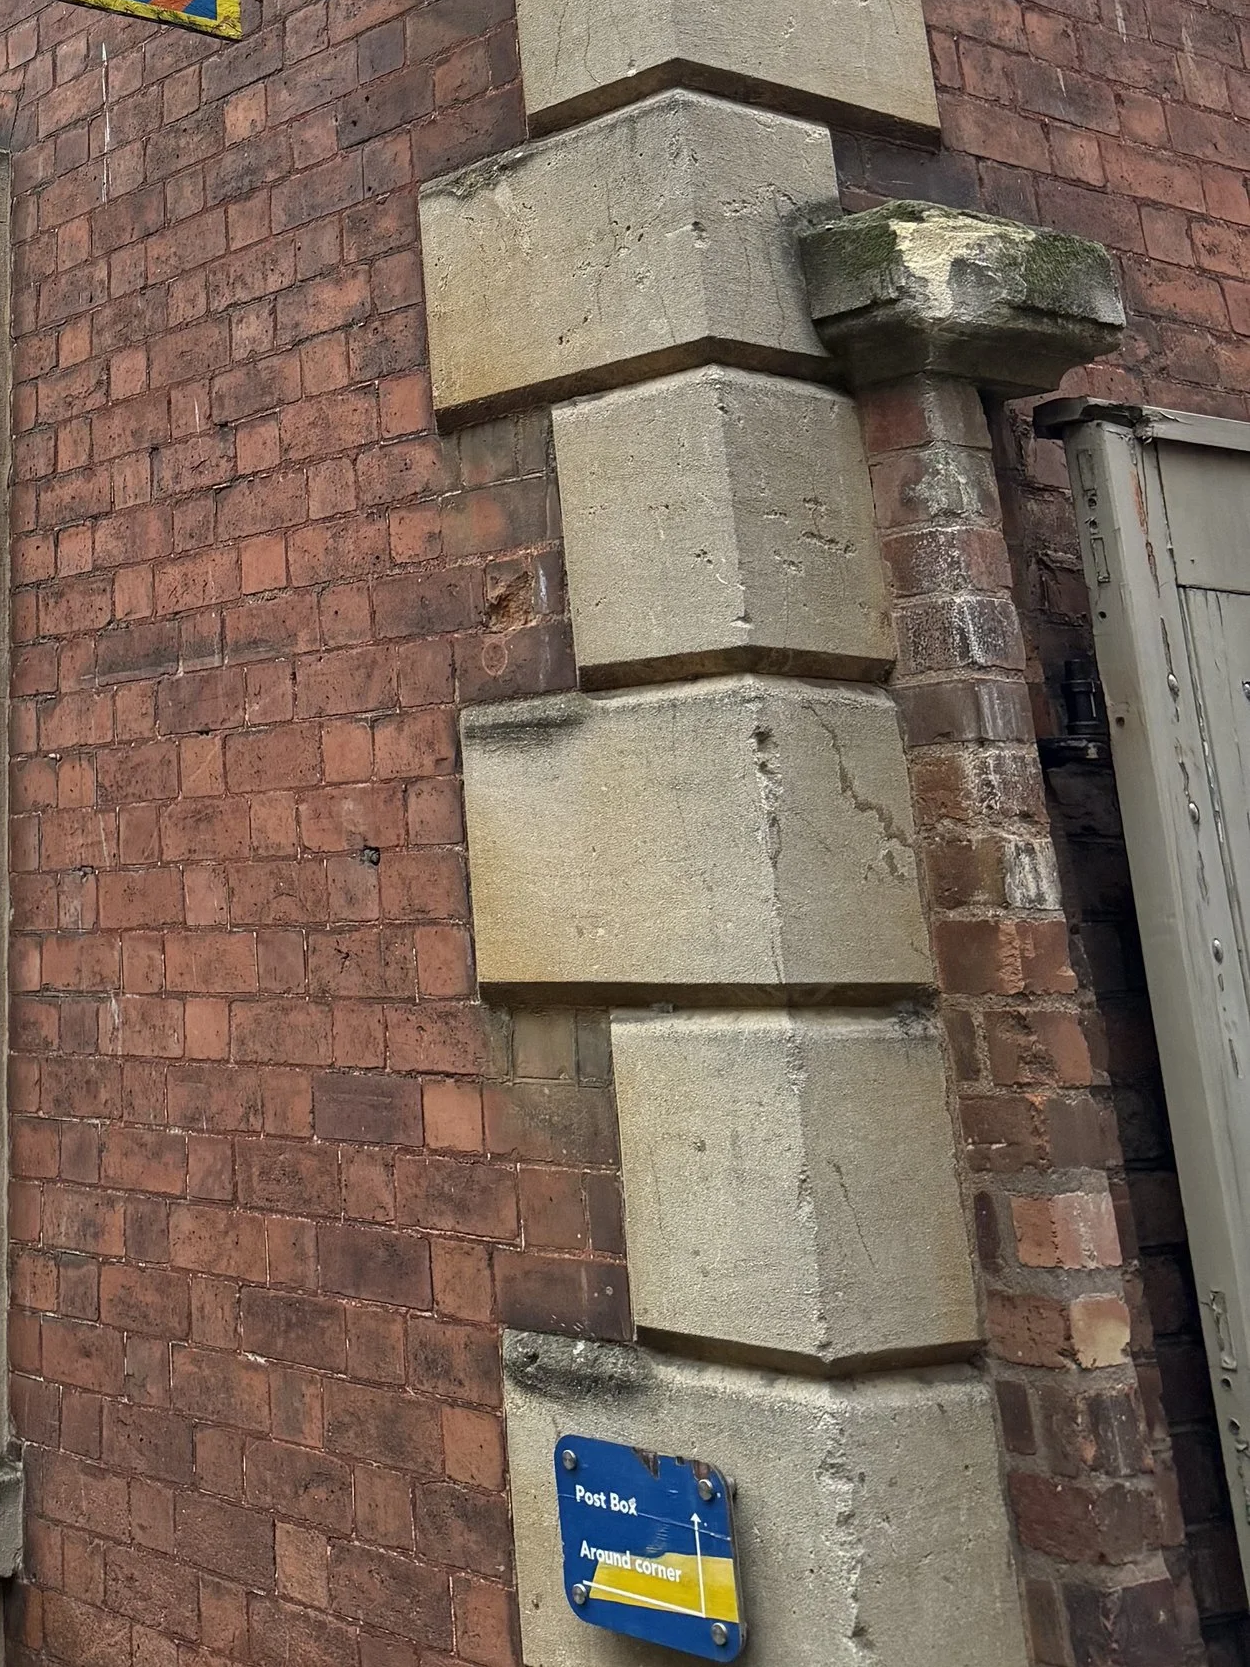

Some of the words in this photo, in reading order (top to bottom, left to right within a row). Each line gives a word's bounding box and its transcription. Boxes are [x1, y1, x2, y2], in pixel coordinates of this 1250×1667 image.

[575, 1484, 607, 1509] Post
[609, 1492, 639, 1517] Box
[579, 1539, 632, 1570] Around
[635, 1558, 683, 1583] corner
